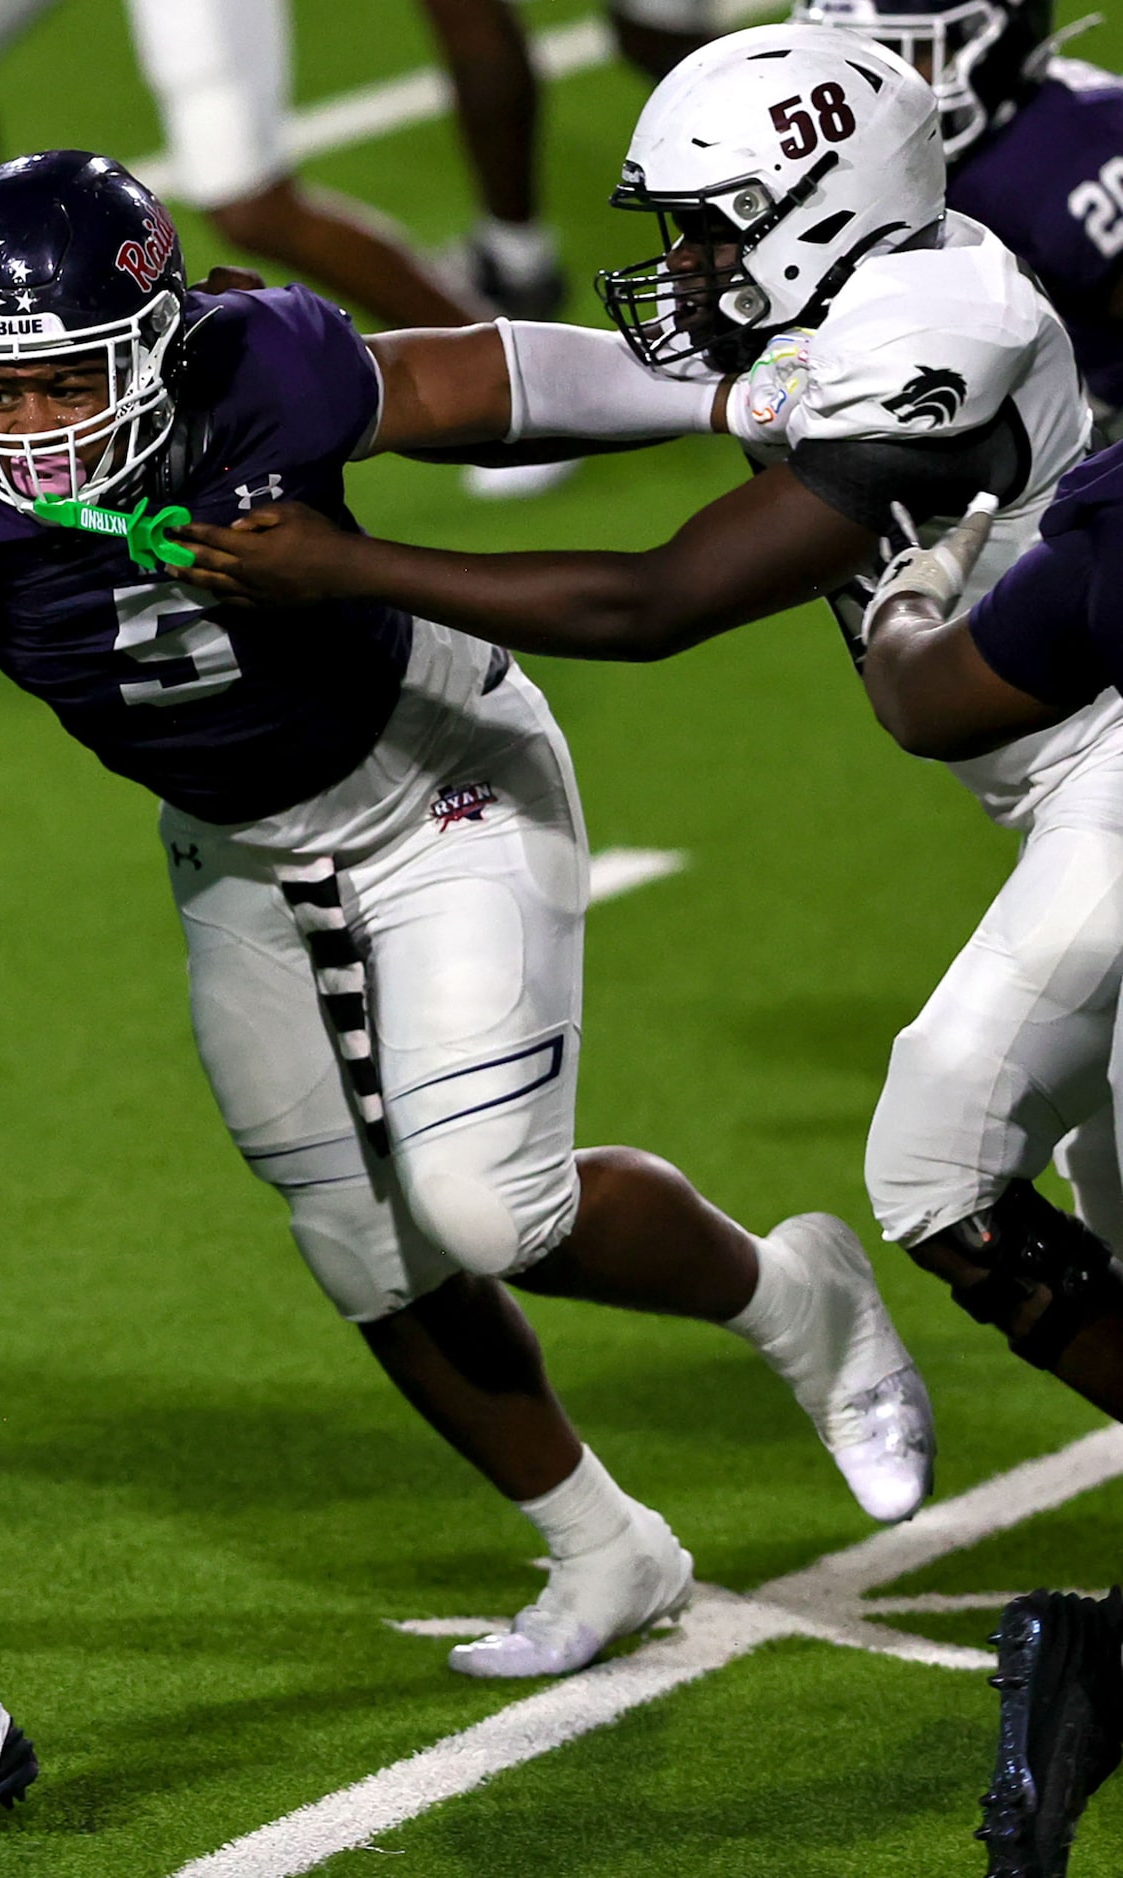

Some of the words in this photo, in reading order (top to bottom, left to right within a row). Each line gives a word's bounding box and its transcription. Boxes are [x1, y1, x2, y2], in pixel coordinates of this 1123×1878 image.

[768, 81, 856, 160] 58
[80, 507, 127, 535] NXTRND
[110, 580, 243, 708] 5
[434, 783, 492, 816] RYAN
